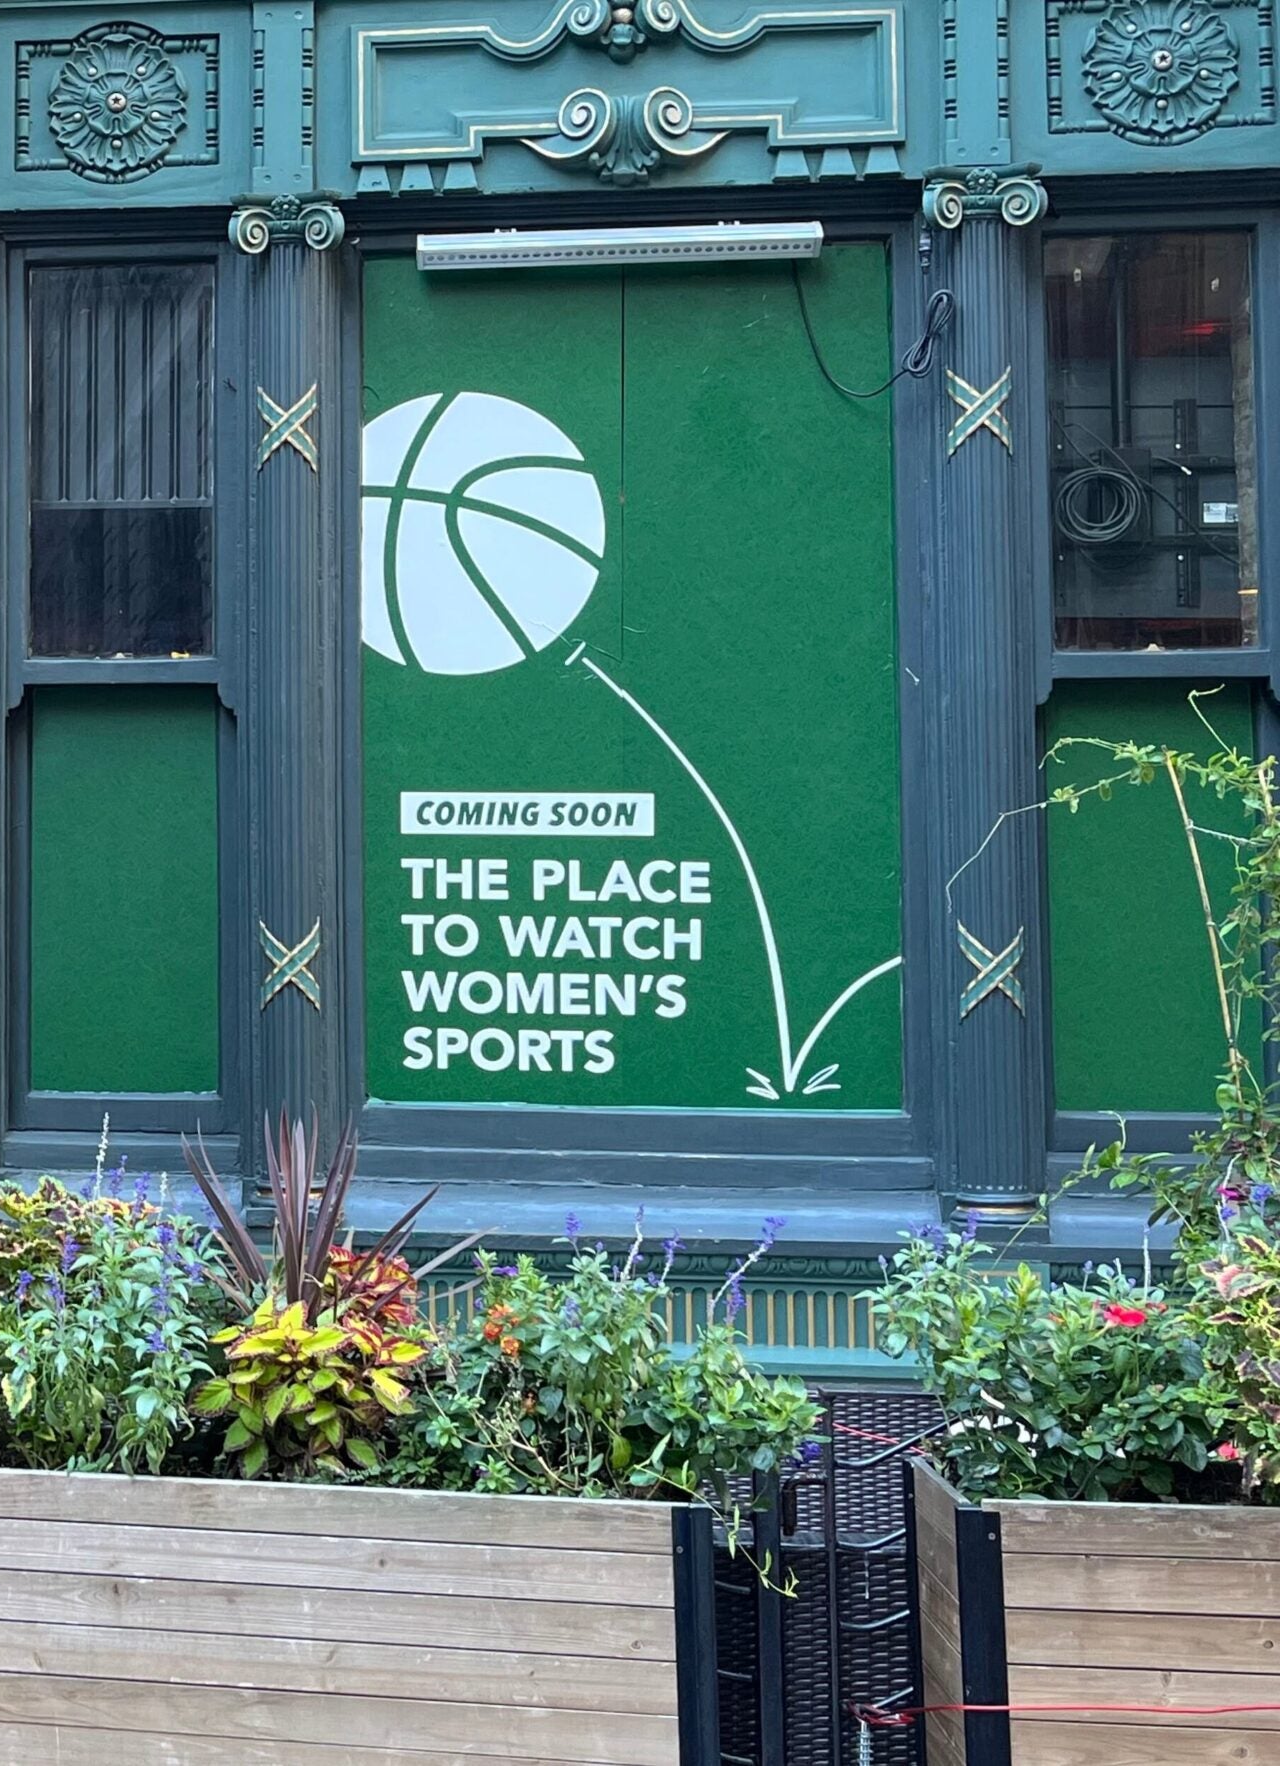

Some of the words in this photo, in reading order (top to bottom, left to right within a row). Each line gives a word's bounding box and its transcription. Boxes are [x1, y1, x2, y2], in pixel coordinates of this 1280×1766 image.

[416, 800, 540, 827] COMING
[548, 801, 638, 827] SOON
[400, 858, 509, 901] THE
[532, 859, 712, 904] PLACE
[400, 913, 479, 957] TO
[499, 914, 702, 961] WATCH
[401, 970, 688, 1019] WOMEN'S
[402, 1026, 615, 1074] SPORTS
